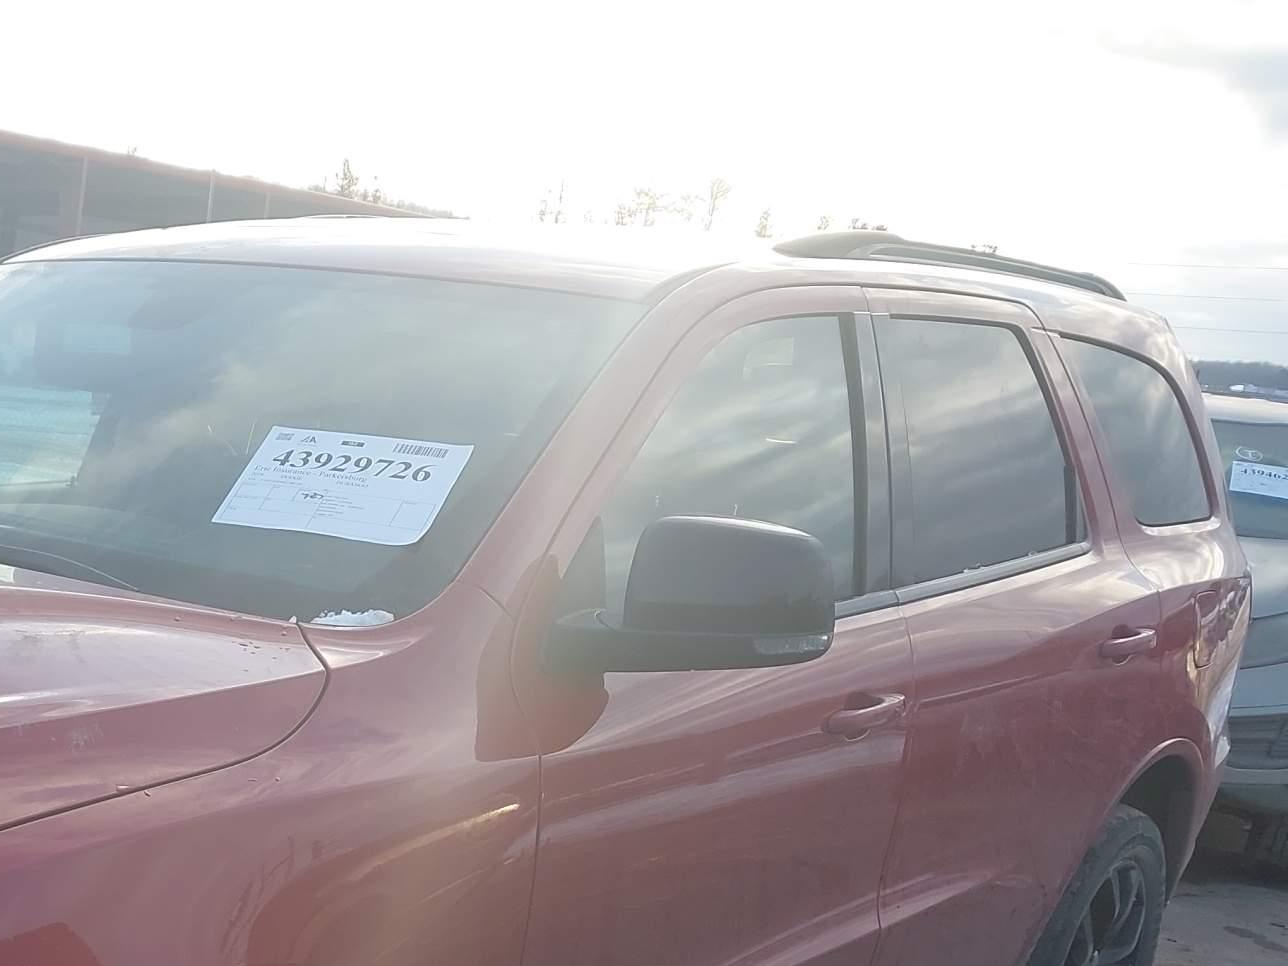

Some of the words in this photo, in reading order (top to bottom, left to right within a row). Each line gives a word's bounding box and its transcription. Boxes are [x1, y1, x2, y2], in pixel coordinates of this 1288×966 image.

[272, 449, 439, 482] 43929726
[273, 467, 313, 476] Insurance
[319, 471, 368, 483] Parkersburg
